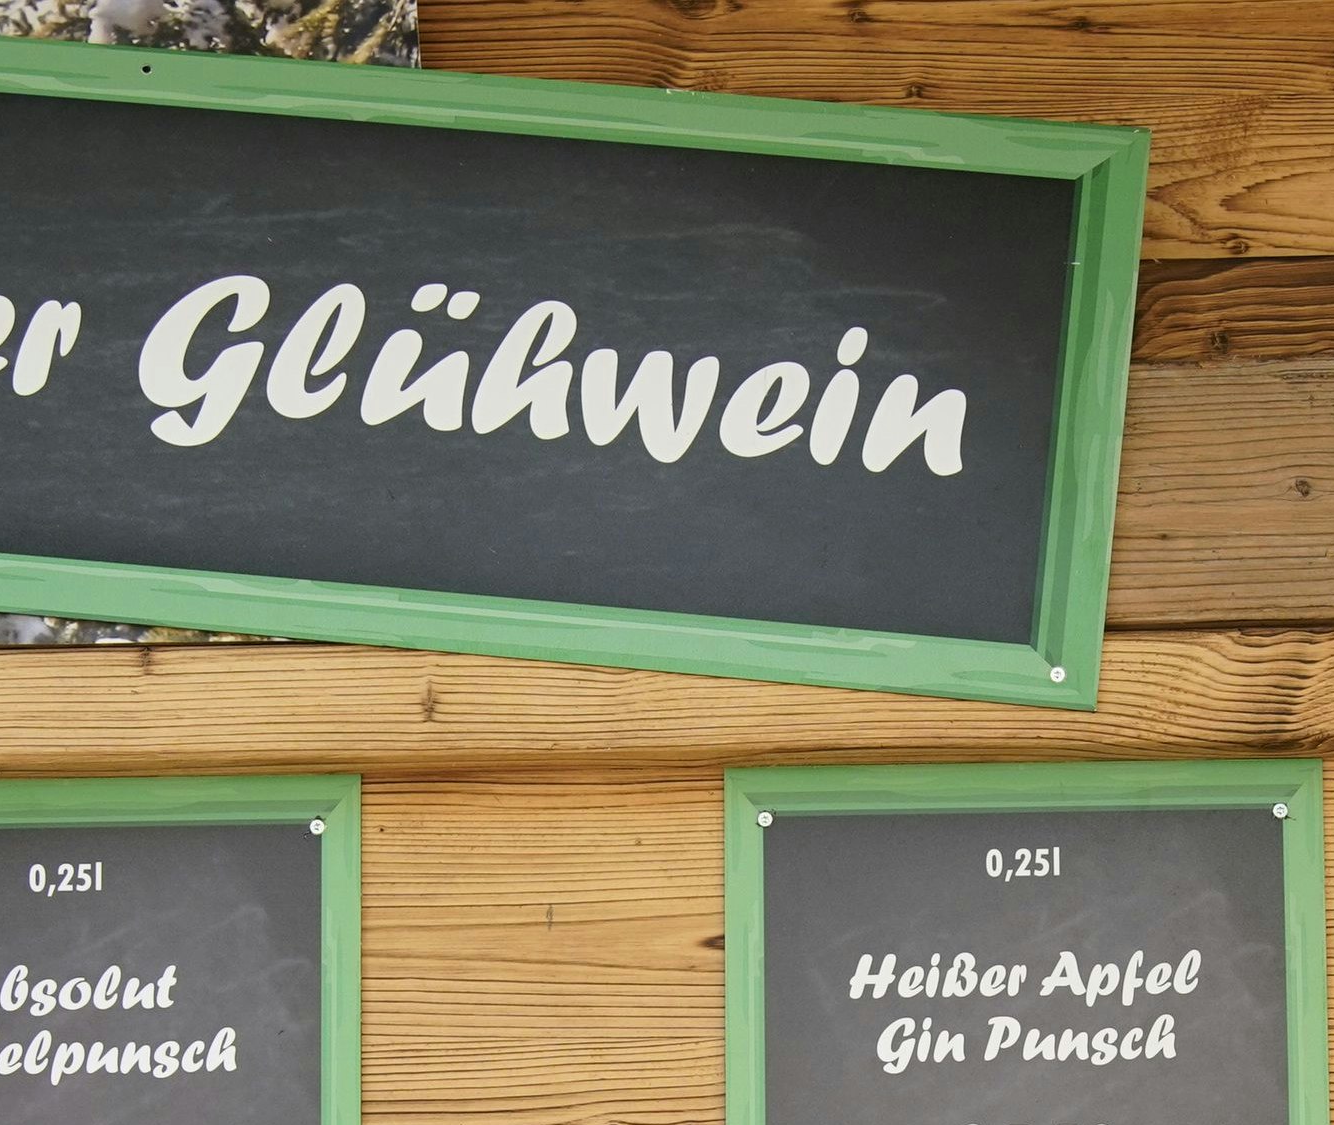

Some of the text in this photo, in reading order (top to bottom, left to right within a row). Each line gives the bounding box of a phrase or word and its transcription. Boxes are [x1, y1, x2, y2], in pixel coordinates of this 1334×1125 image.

[138, 275, 967, 477] Glühwein
[28, 861, 103, 898] 0,25l
[985, 846, 1061, 883] 0,25l
[849, 949, 1202, 1008] Heißer Apfel
[876, 1013, 1177, 1075] Gin Punsch
